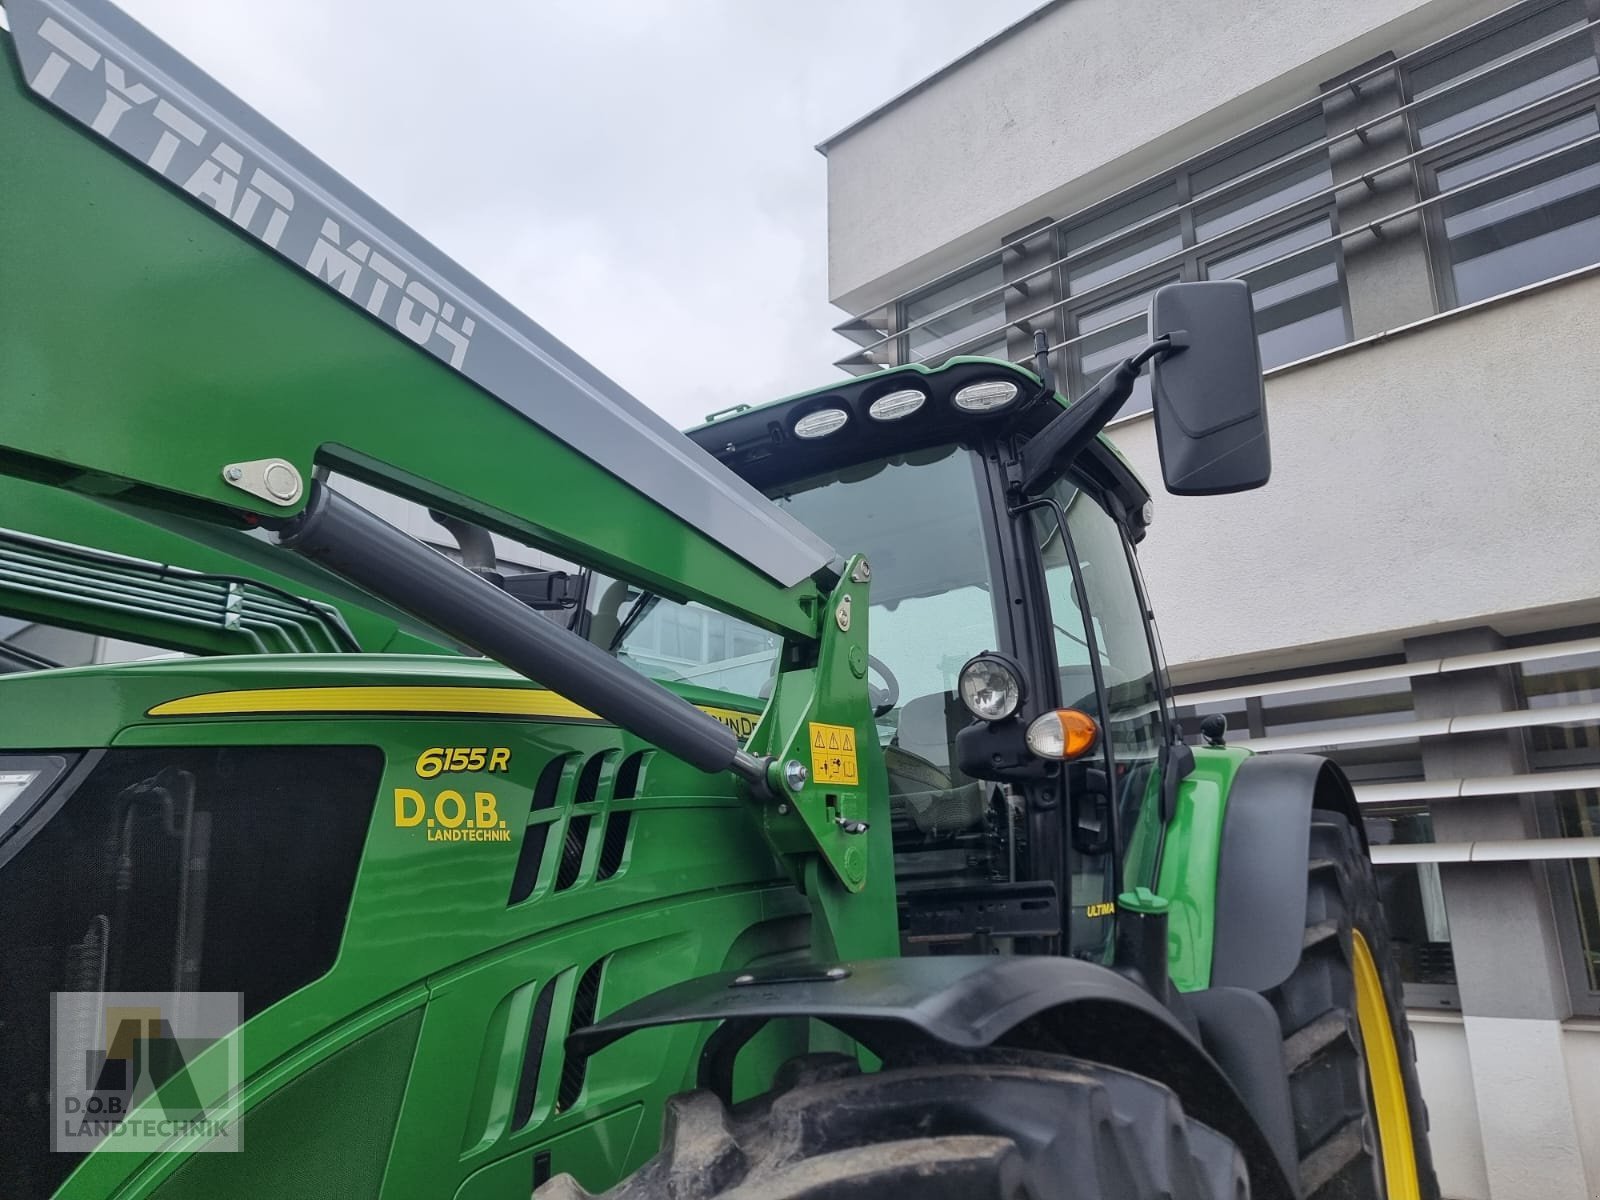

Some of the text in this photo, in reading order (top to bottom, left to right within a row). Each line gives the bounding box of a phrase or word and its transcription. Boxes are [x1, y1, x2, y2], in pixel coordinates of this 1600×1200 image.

[30, 17, 295, 250] TYTAN
[415, 747, 487, 778] 6155
[394, 788, 506, 828] D.O.B.
[427, 829, 511, 841] LANDTECHNIK
